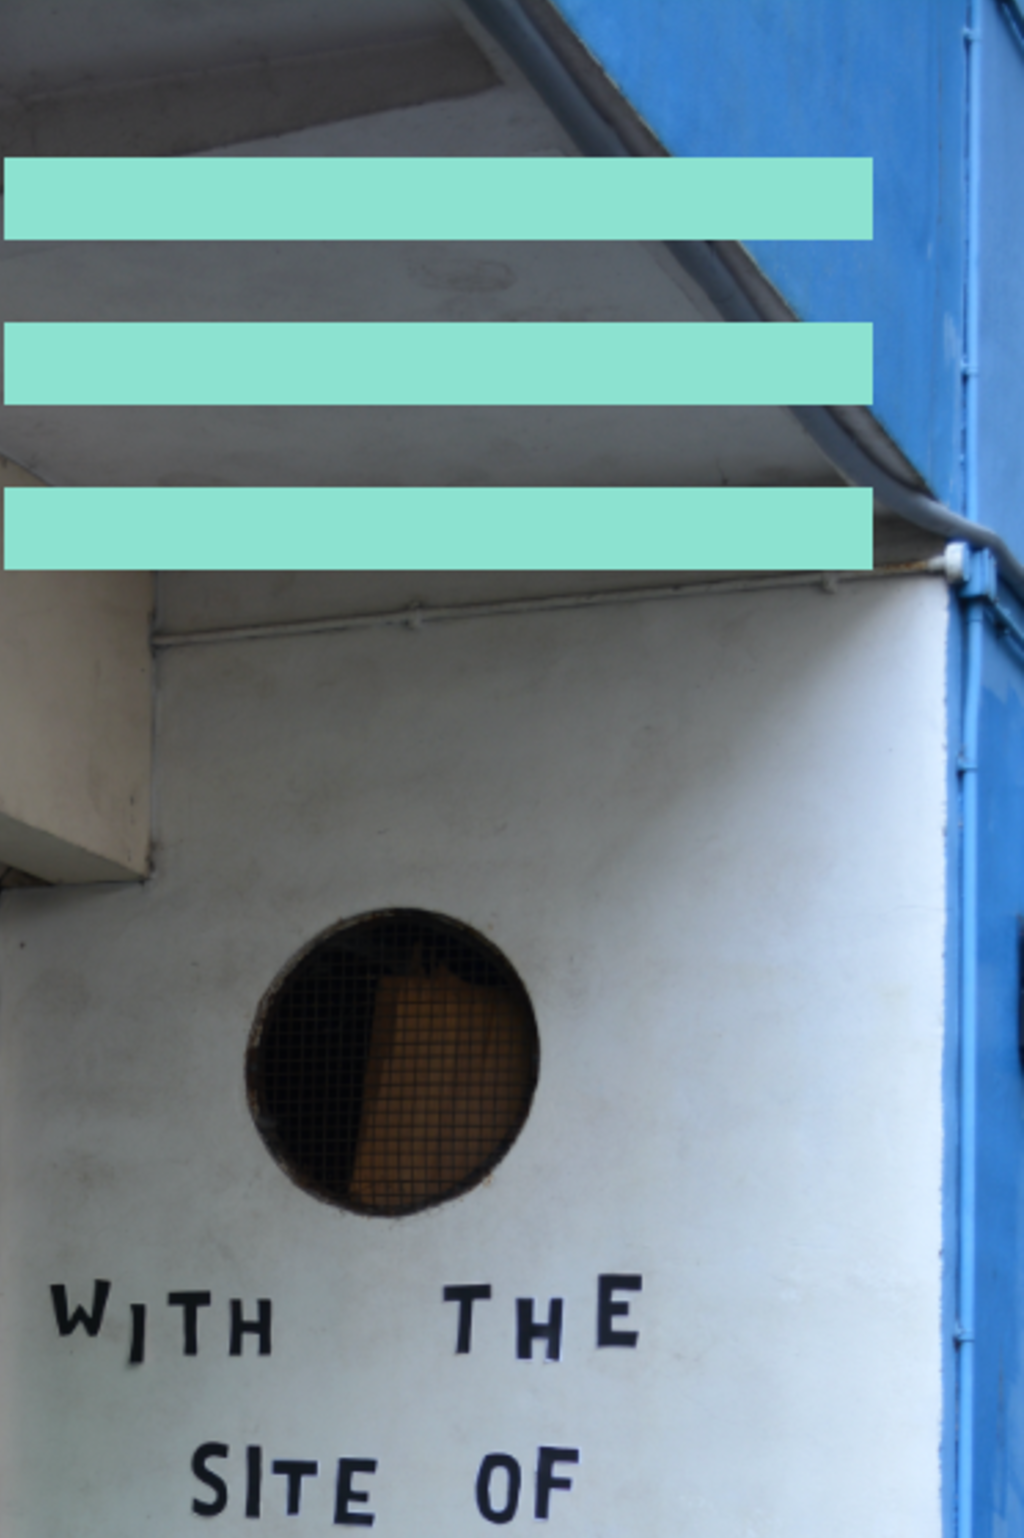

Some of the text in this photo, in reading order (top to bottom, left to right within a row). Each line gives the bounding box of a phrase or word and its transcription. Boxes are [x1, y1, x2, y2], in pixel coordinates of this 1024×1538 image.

[50, 1273, 643, 1366] WITH THE
[191, 1441, 580, 1527] SITE OF
